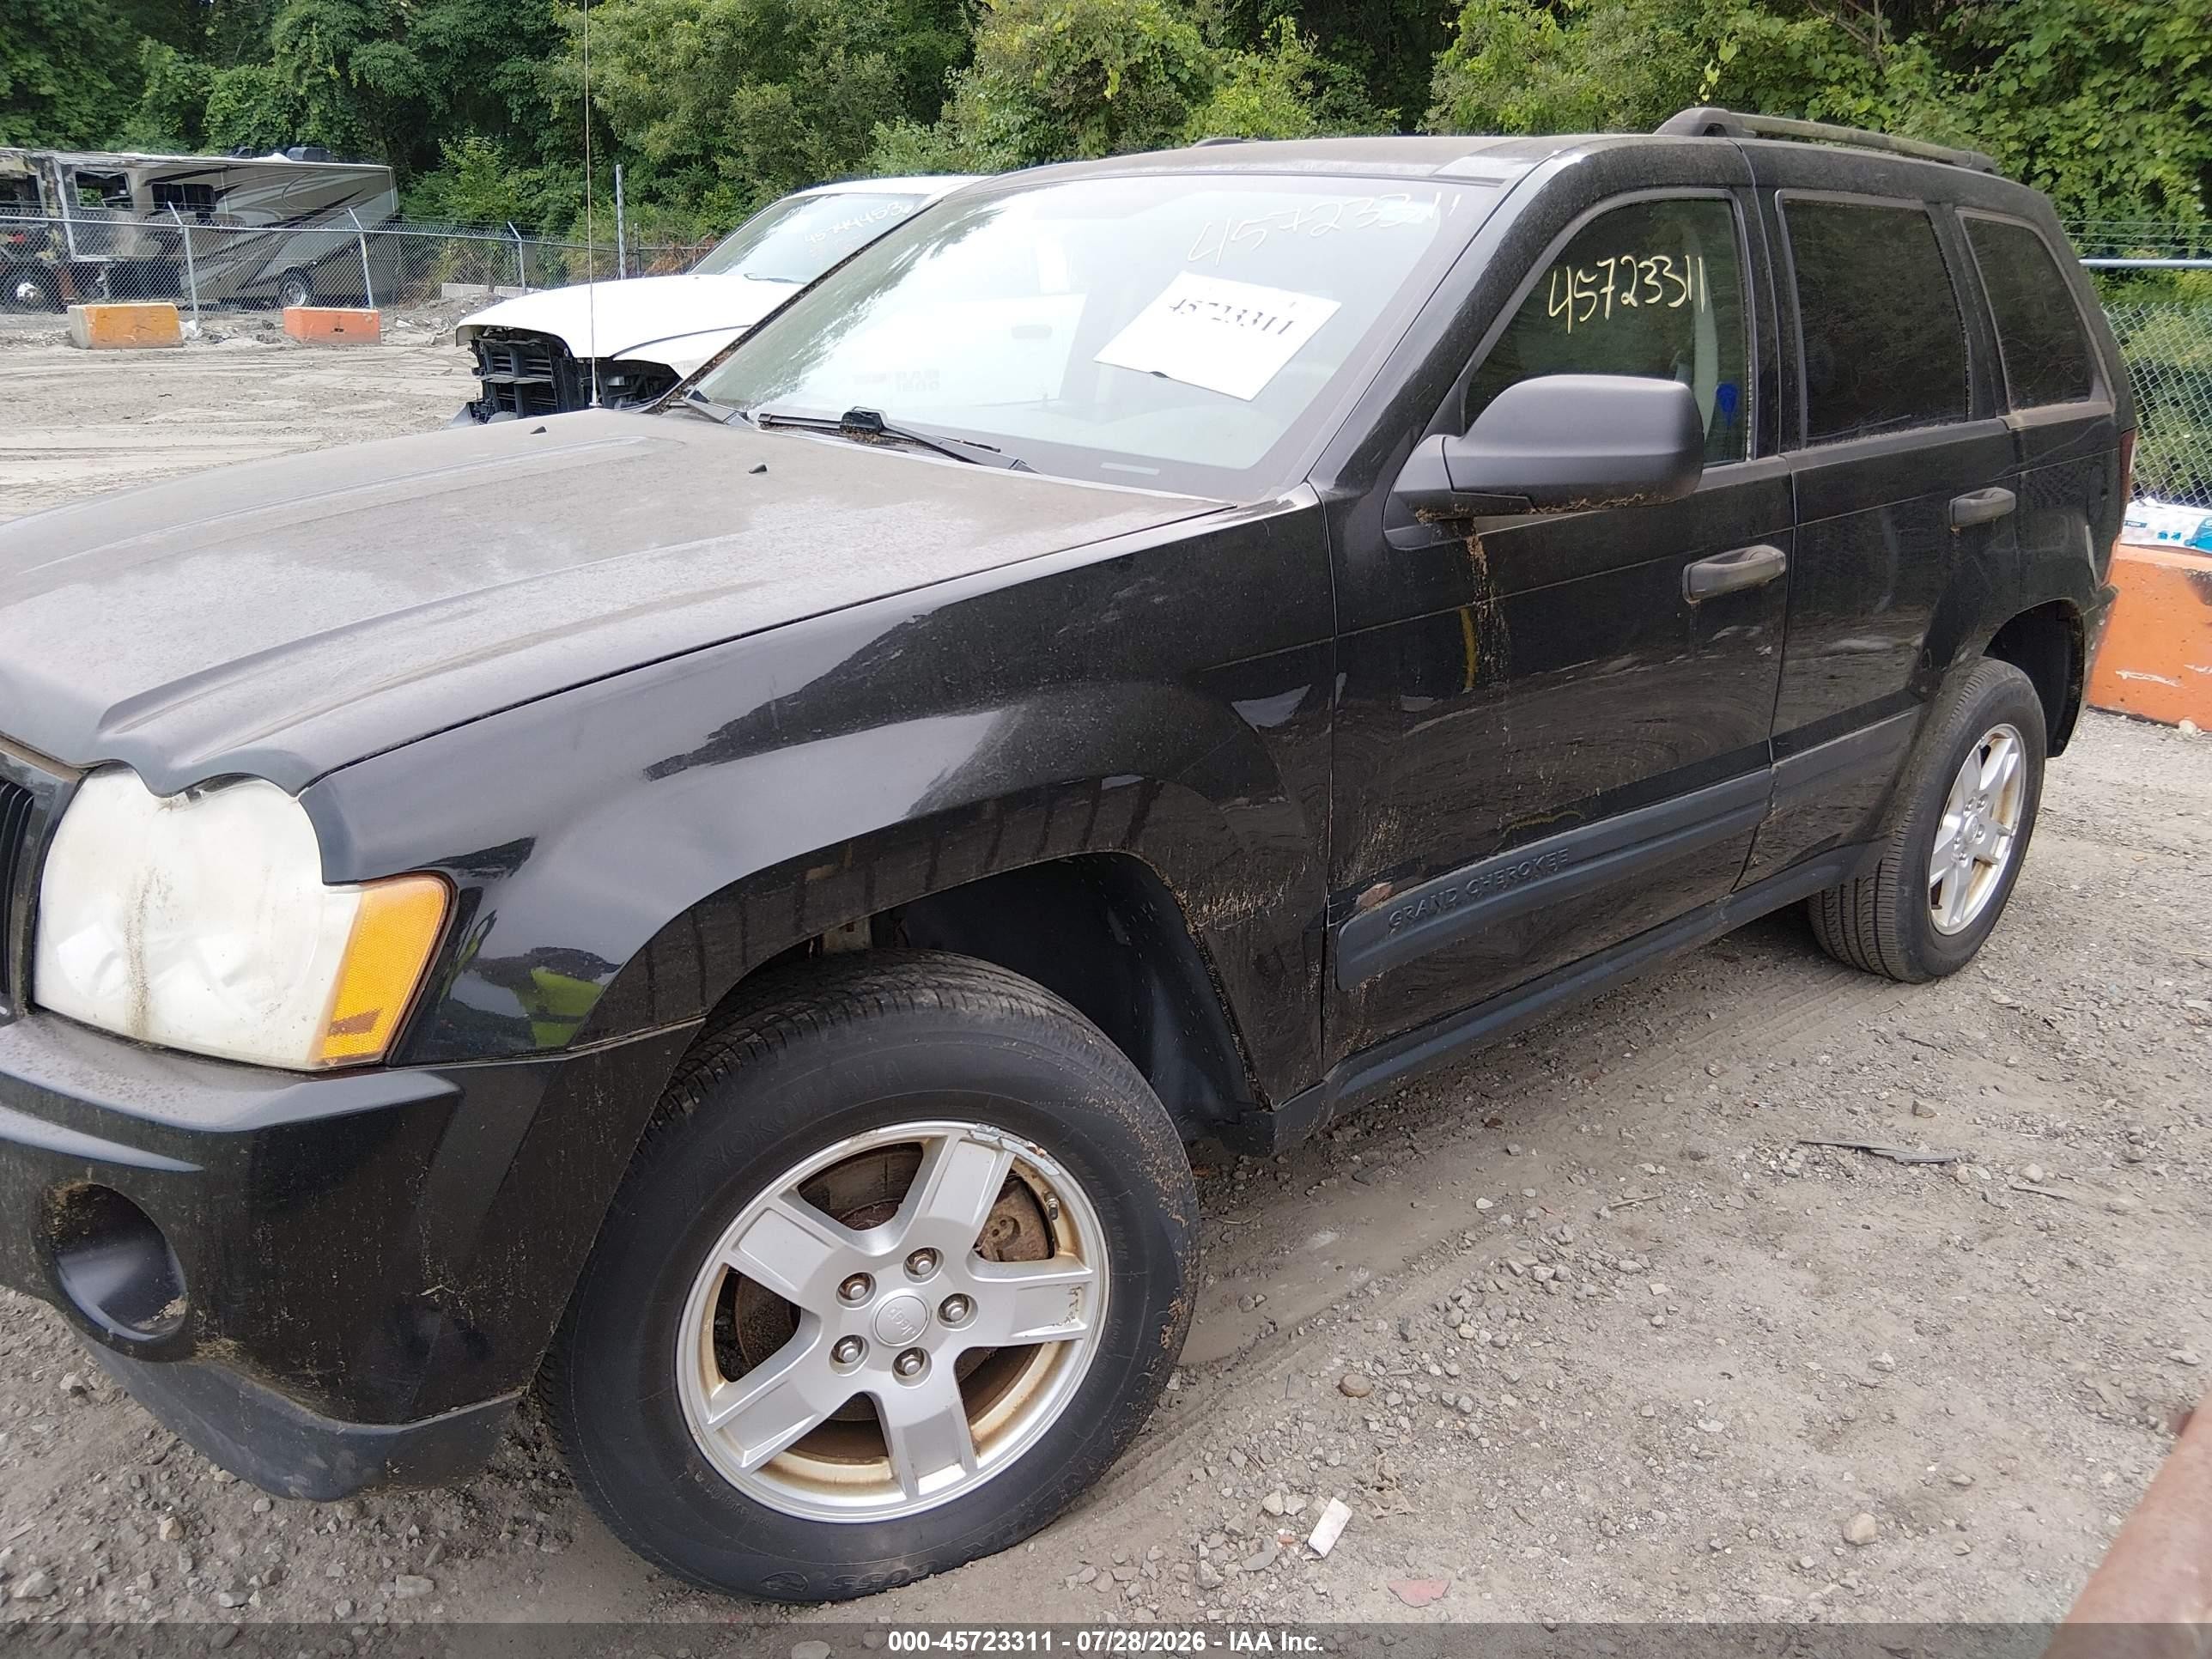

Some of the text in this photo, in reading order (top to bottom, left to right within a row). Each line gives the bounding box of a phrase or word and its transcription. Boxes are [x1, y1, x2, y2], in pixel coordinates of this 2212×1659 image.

[1548, 254, 1706, 335] 45723311
[1389, 848, 1569, 927] GRAND CHEROKEE
[887, 1306, 917, 1338] Jeep
